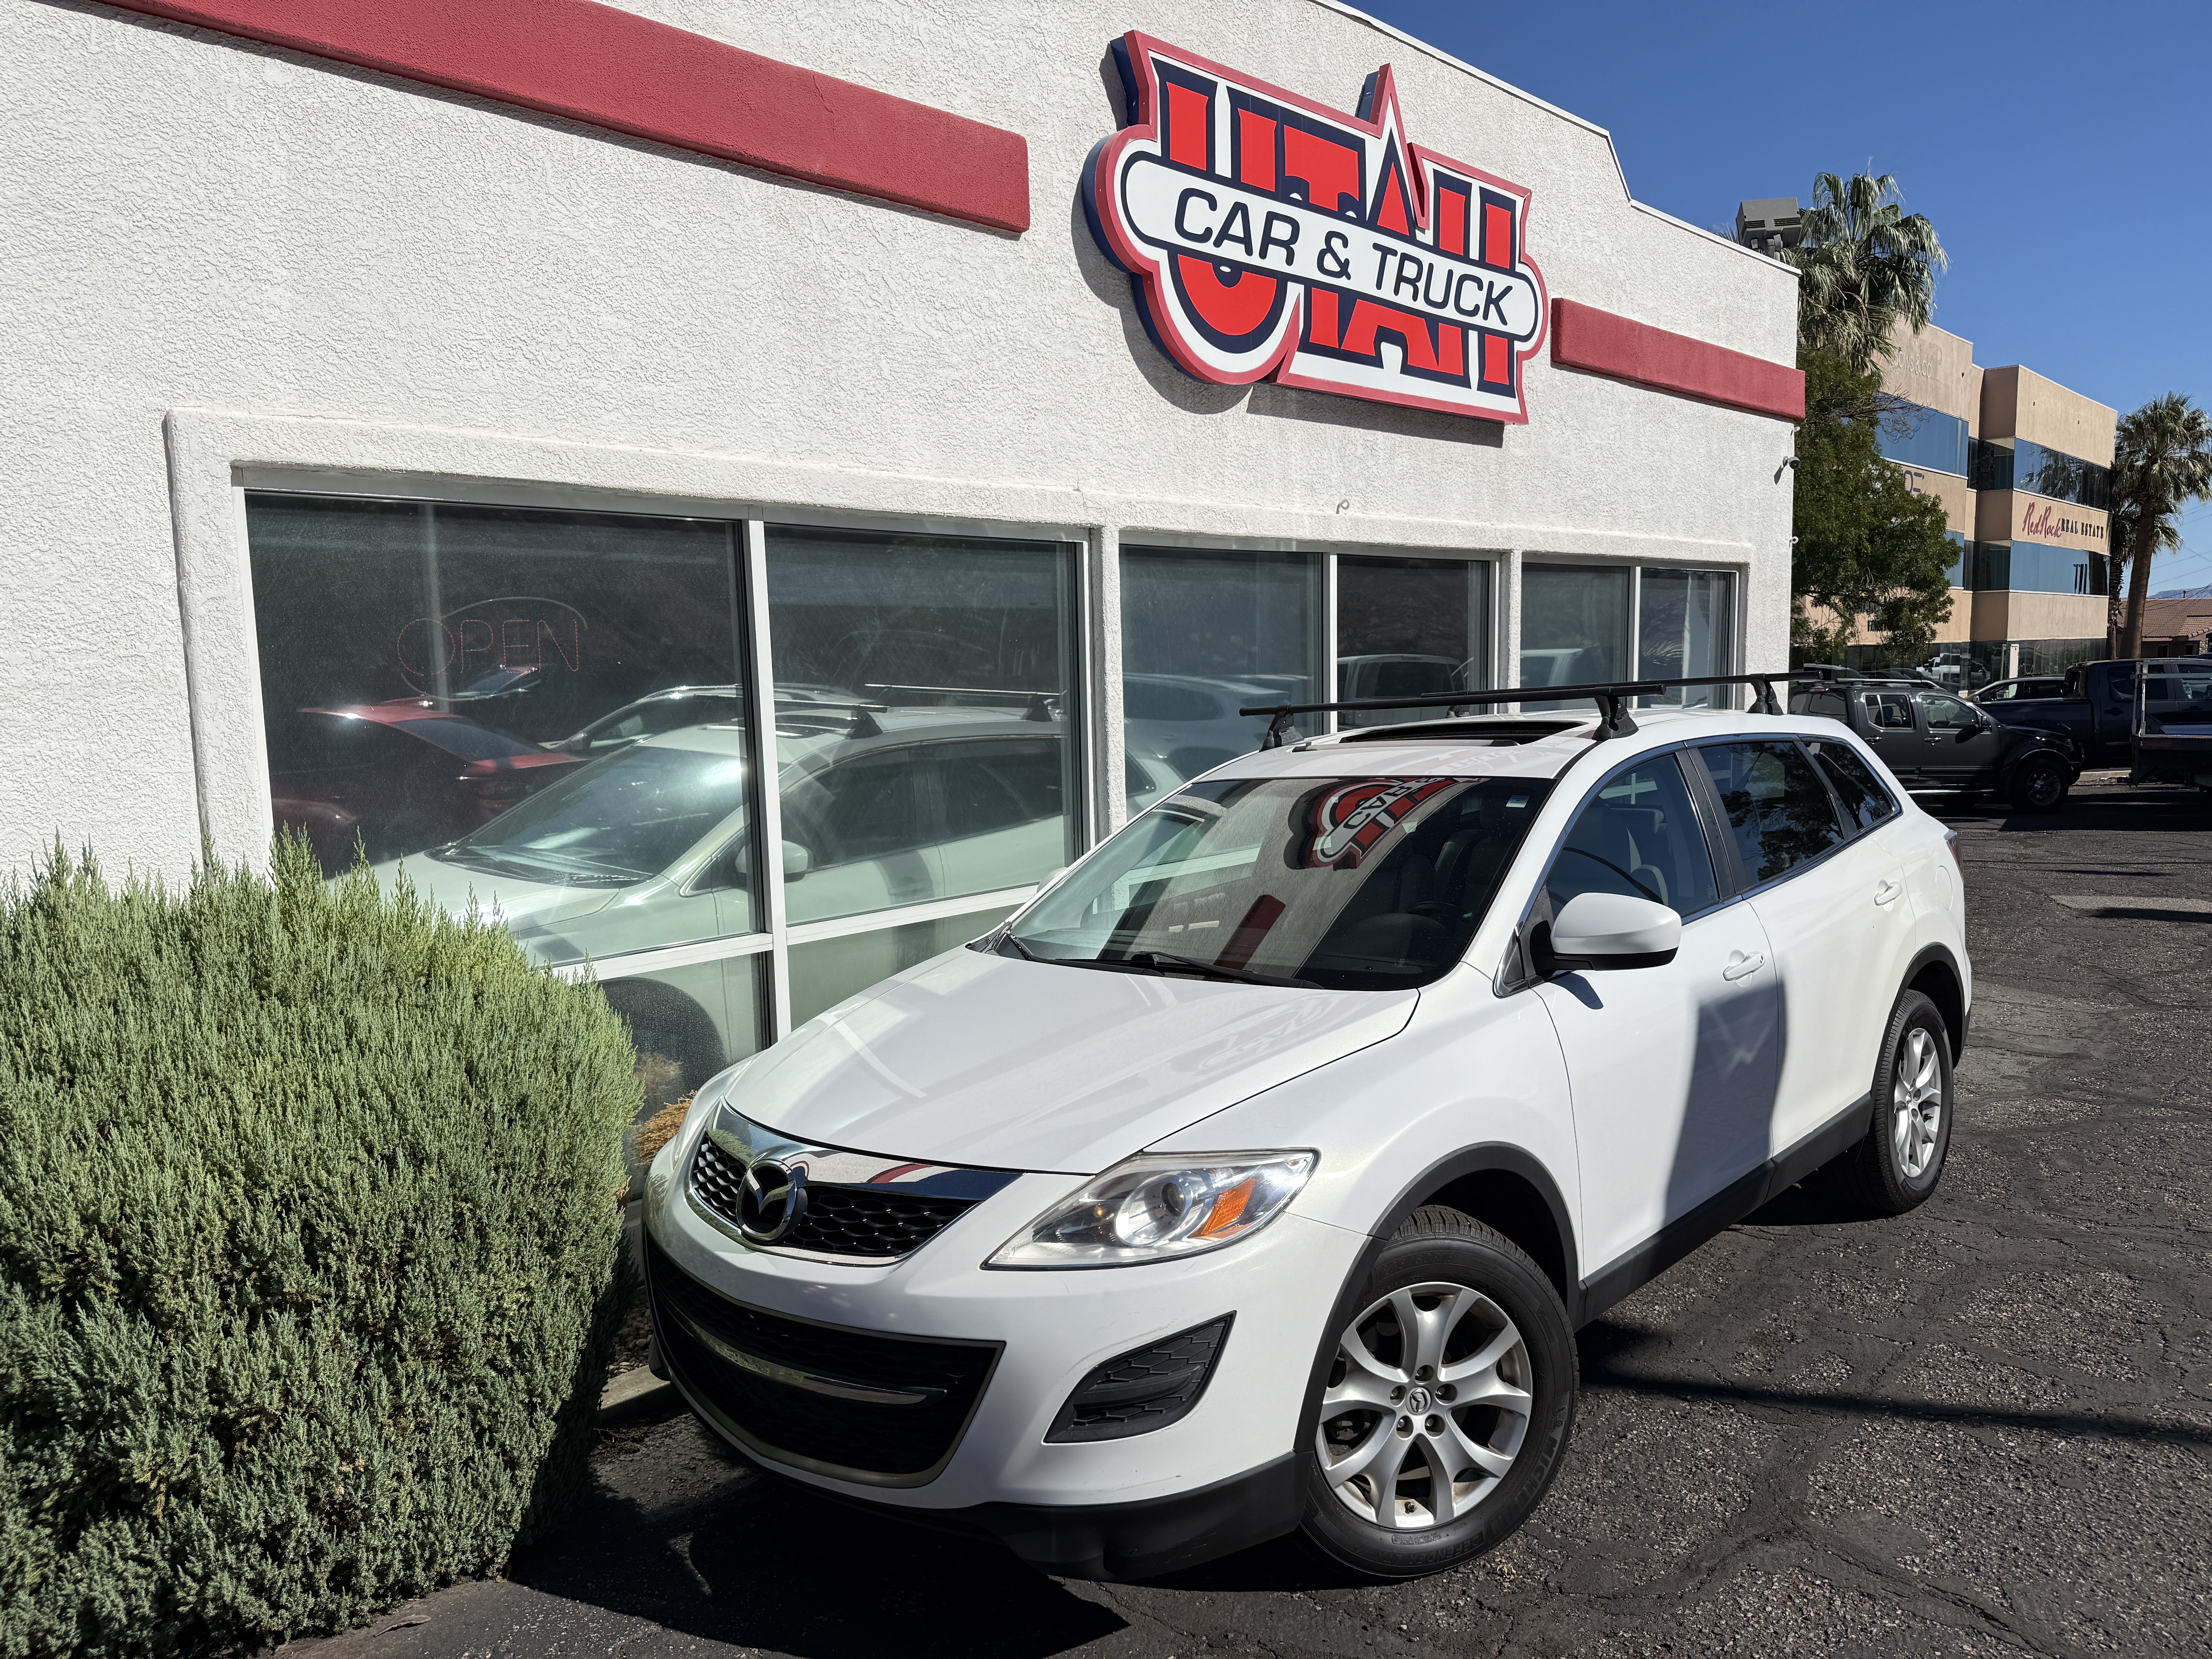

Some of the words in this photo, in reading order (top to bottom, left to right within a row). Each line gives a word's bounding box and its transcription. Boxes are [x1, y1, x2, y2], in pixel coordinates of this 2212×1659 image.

[1150, 57, 1516, 399] UTAH
[1174, 187, 1300, 266] CAR
[1317, 230, 1351, 280] &
[1372, 242, 1513, 326] TRUCK
[1915, 354, 1921, 376] &
[2061, 518, 2078, 534] REAL
[2081, 522, 2104, 539] ESTATE
[397, 618, 579, 677] OPEN
